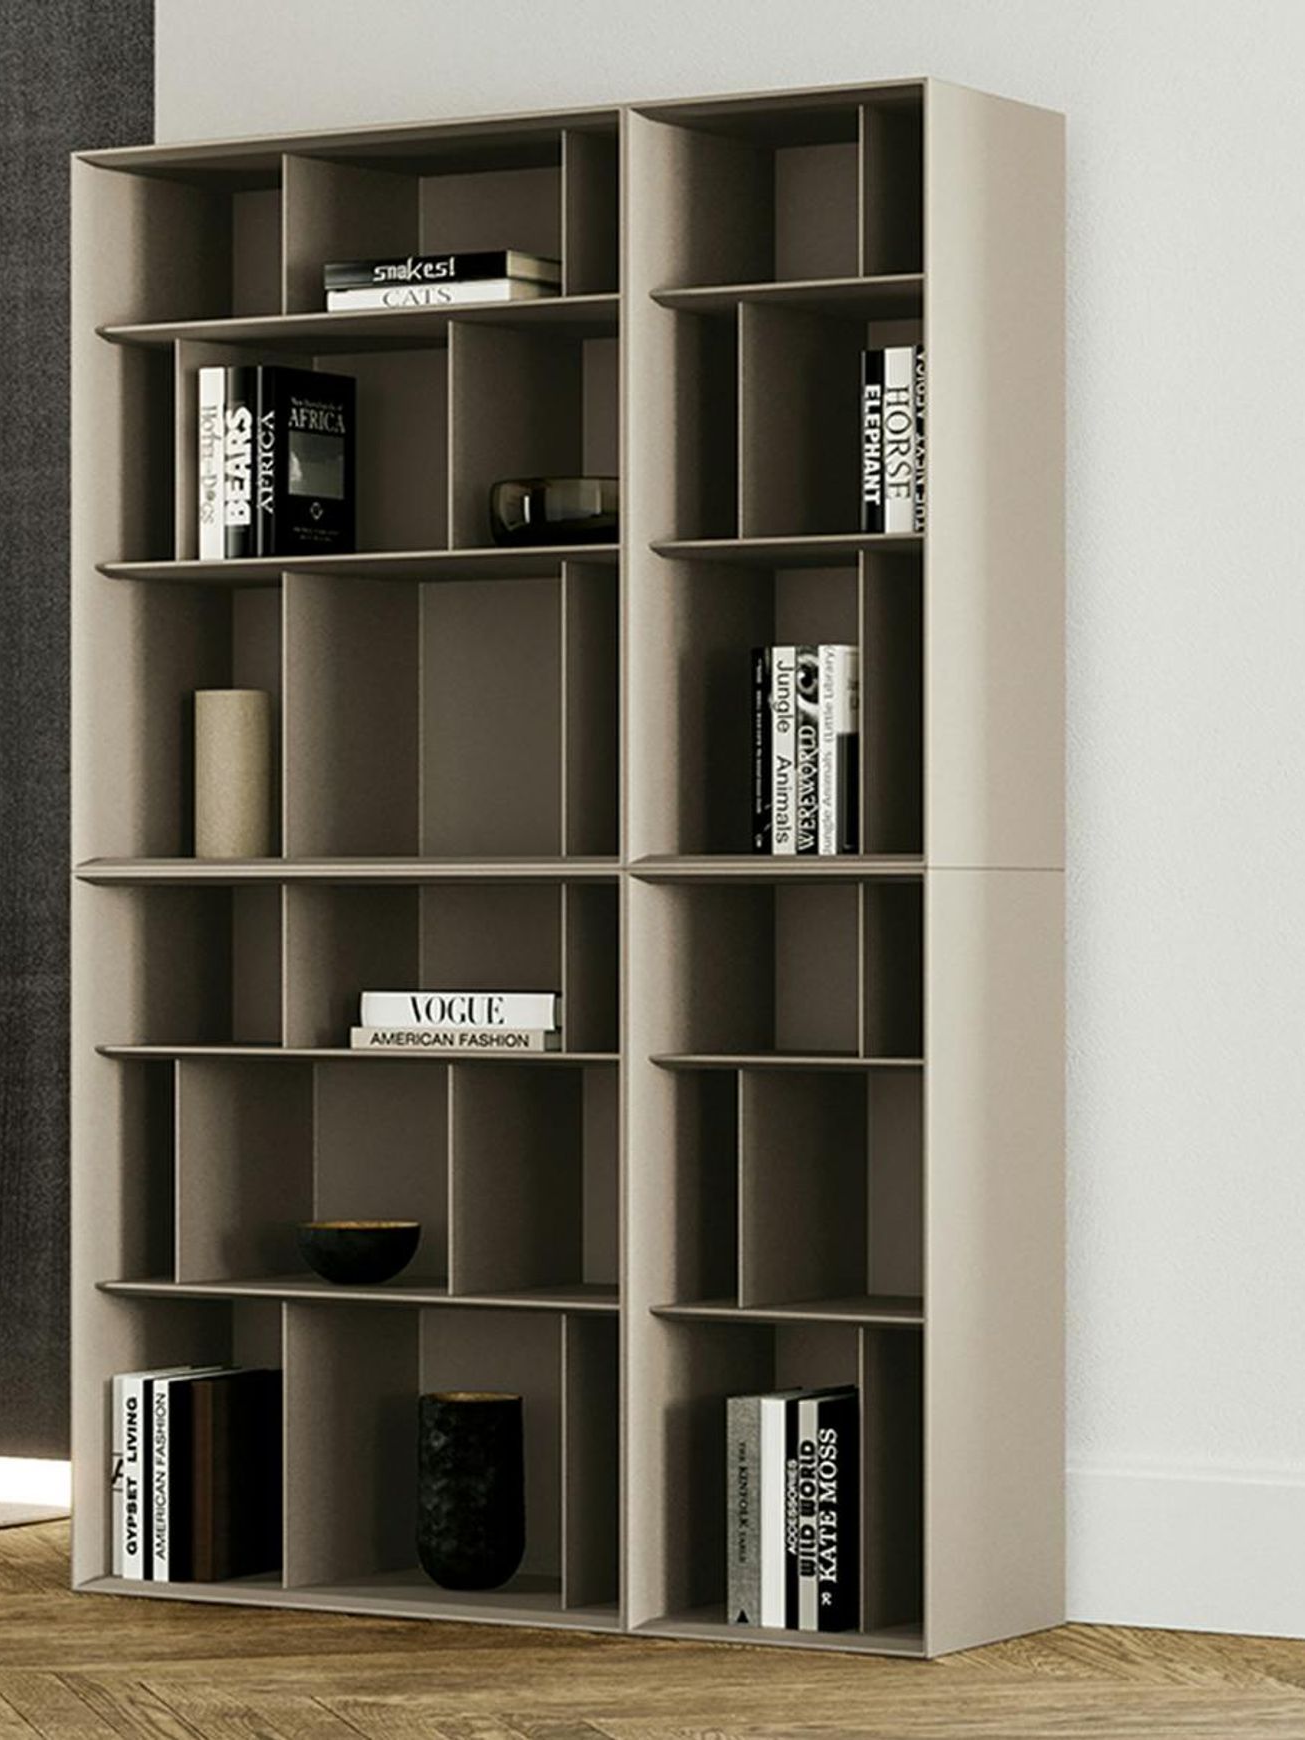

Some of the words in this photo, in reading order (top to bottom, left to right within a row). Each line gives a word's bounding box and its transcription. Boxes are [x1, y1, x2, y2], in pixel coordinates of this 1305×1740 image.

[373, 256, 456, 282] snakes!
[382, 287, 452, 308] CATS
[288, 407, 346, 434] AFRICA
[864, 385, 881, 505] ELEPHANT
[885, 386, 912, 500] HORSE
[225, 406, 253, 526] BEARS
[257, 410, 276, 514] AFRICA
[772, 660, 794, 733] Jungle
[775, 755, 793, 844] Animals
[797, 725, 819, 850] WEREWORLD
[369, 1032, 455, 1047] AMERICAN
[459, 1033, 530, 1048] FASHION
[410, 996, 505, 1025] VOGUE
[126, 1397, 138, 1463] LIVING
[155, 1392, 166, 1465] FASHION
[818, 1427, 838, 1504] MOSS
[126, 1476, 138, 1555] GYPSET
[155, 1471, 166, 1560] AMERICAN
[787, 1459, 798, 1555] ACCESSORIES
[799, 1440, 817, 1517] WORLD
[799, 1523, 817, 1578] WILD
[818, 1510, 838, 1583] KATE
